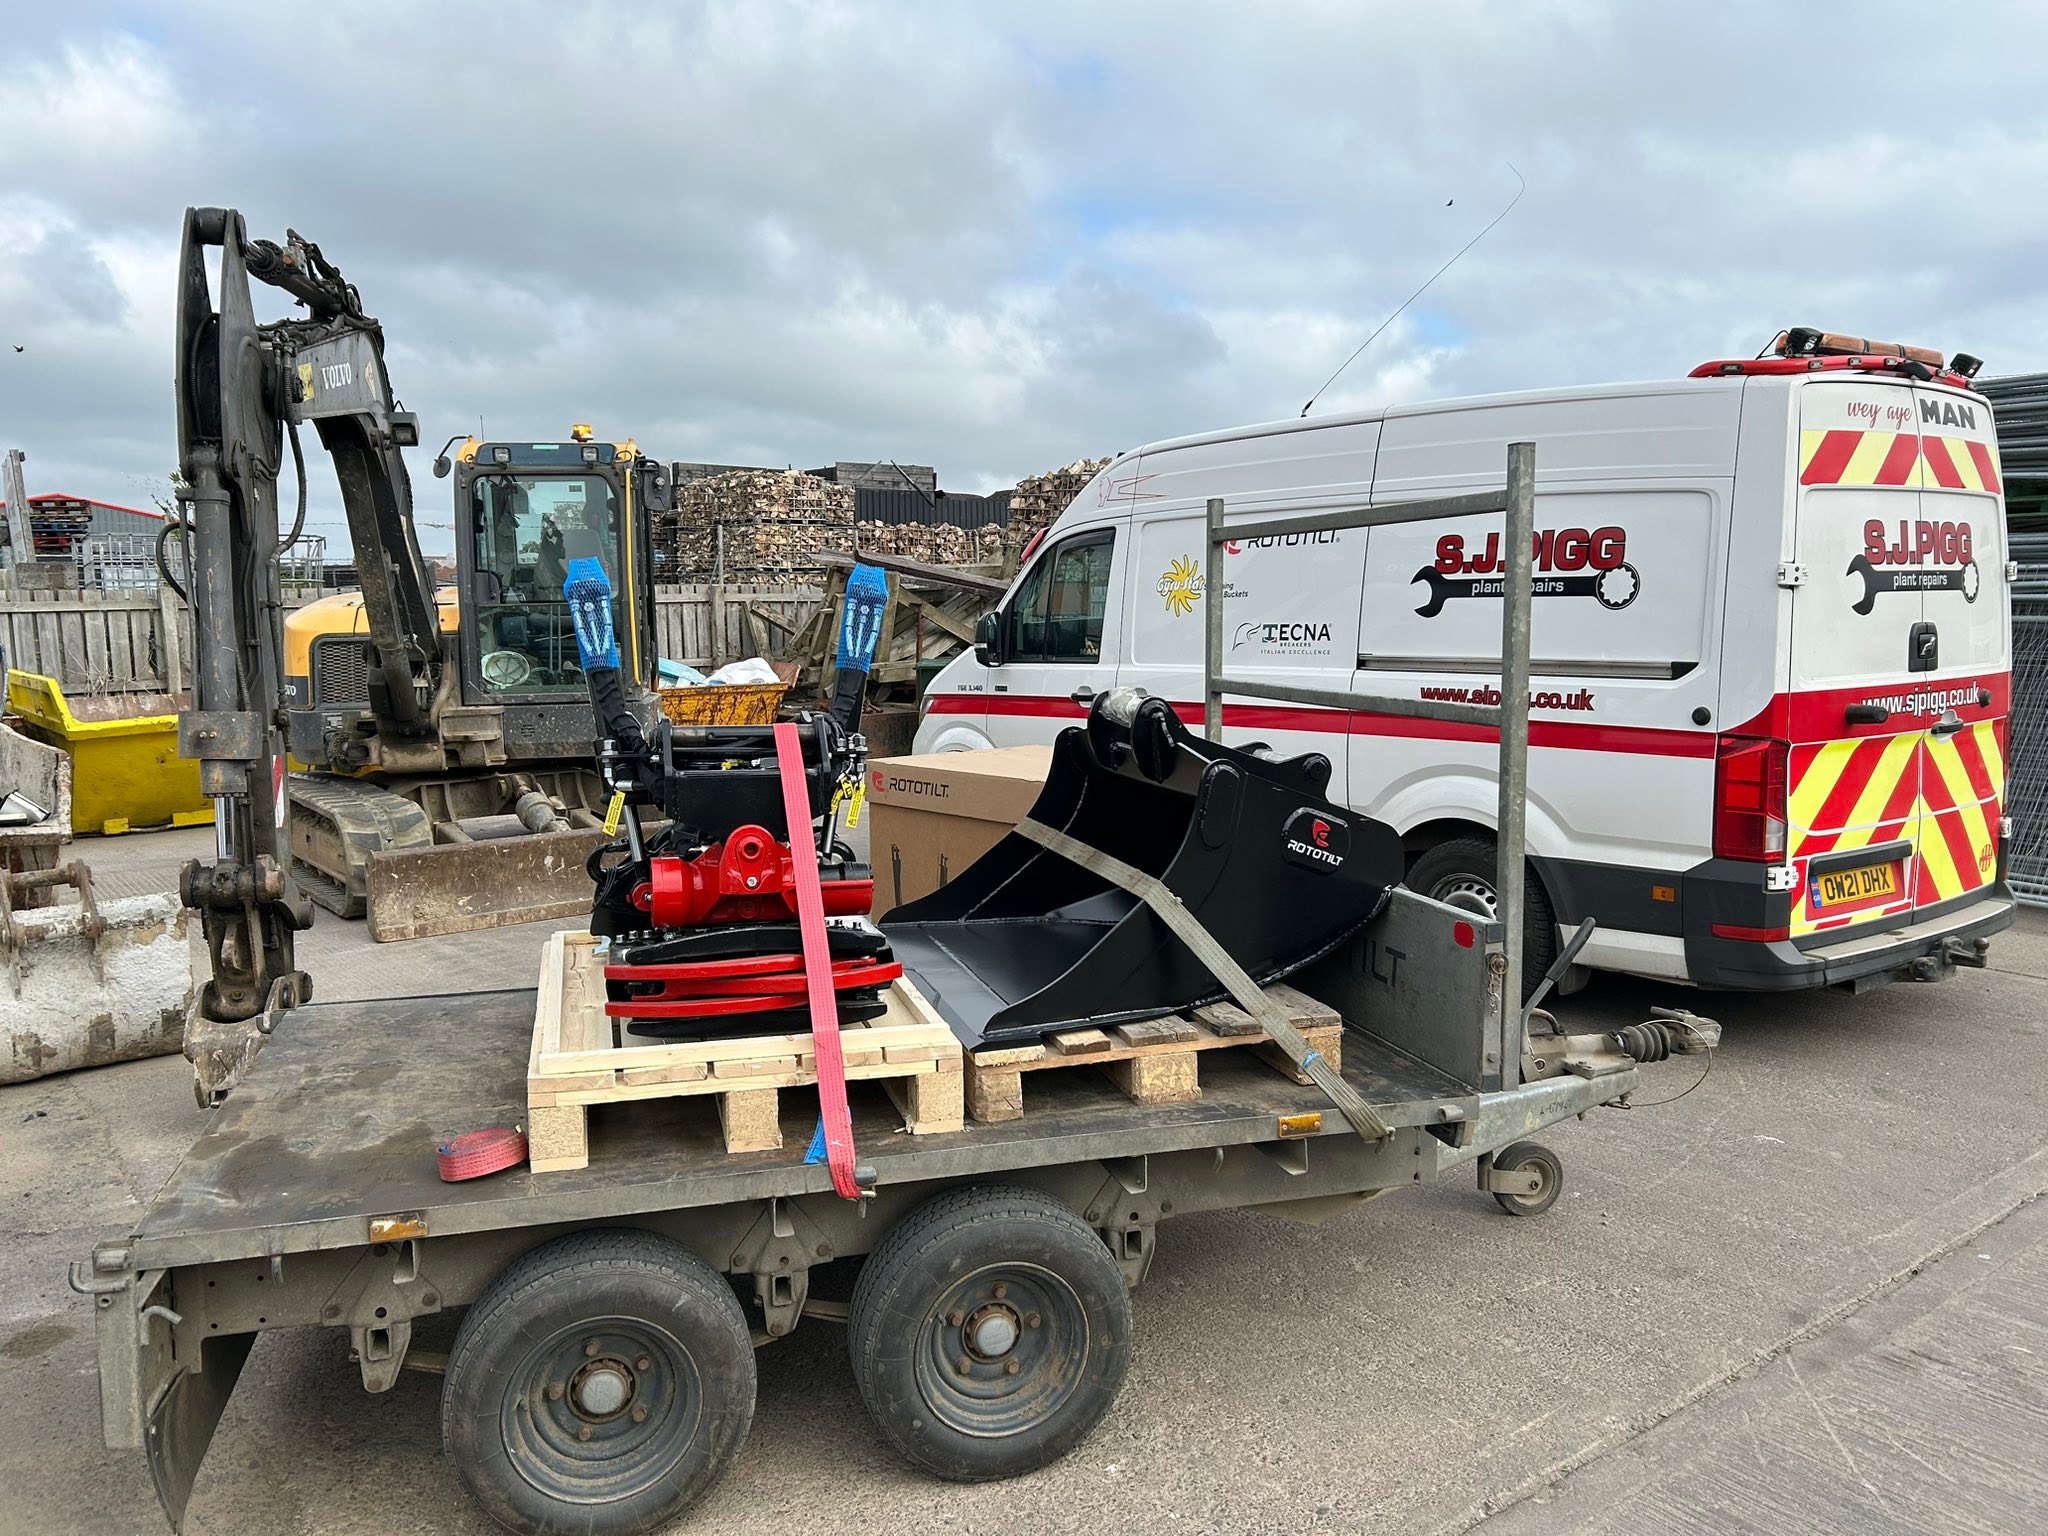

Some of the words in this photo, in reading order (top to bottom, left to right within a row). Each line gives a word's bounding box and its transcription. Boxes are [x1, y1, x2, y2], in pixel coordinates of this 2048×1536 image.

[321, 362, 352, 390] VOLVO
[1847, 402, 1881, 428] wey
[1887, 405, 1913, 430] aye
[1919, 398, 1976, 430] MAN
[1864, 519, 1972, 566] S.J.PIGG
[1472, 579, 1504, 596] plant
[1893, 571, 1916, 590] plant
[1918, 572, 1948, 589] repairs
[1261, 622, 1331, 643] TECNA
[889, 777, 949, 798] ROTOTILT
[1287, 838, 1344, 867] ROTOTILT
[1823, 873, 1861, 901] OW21
[1862, 866, 1891, 894] DHX
